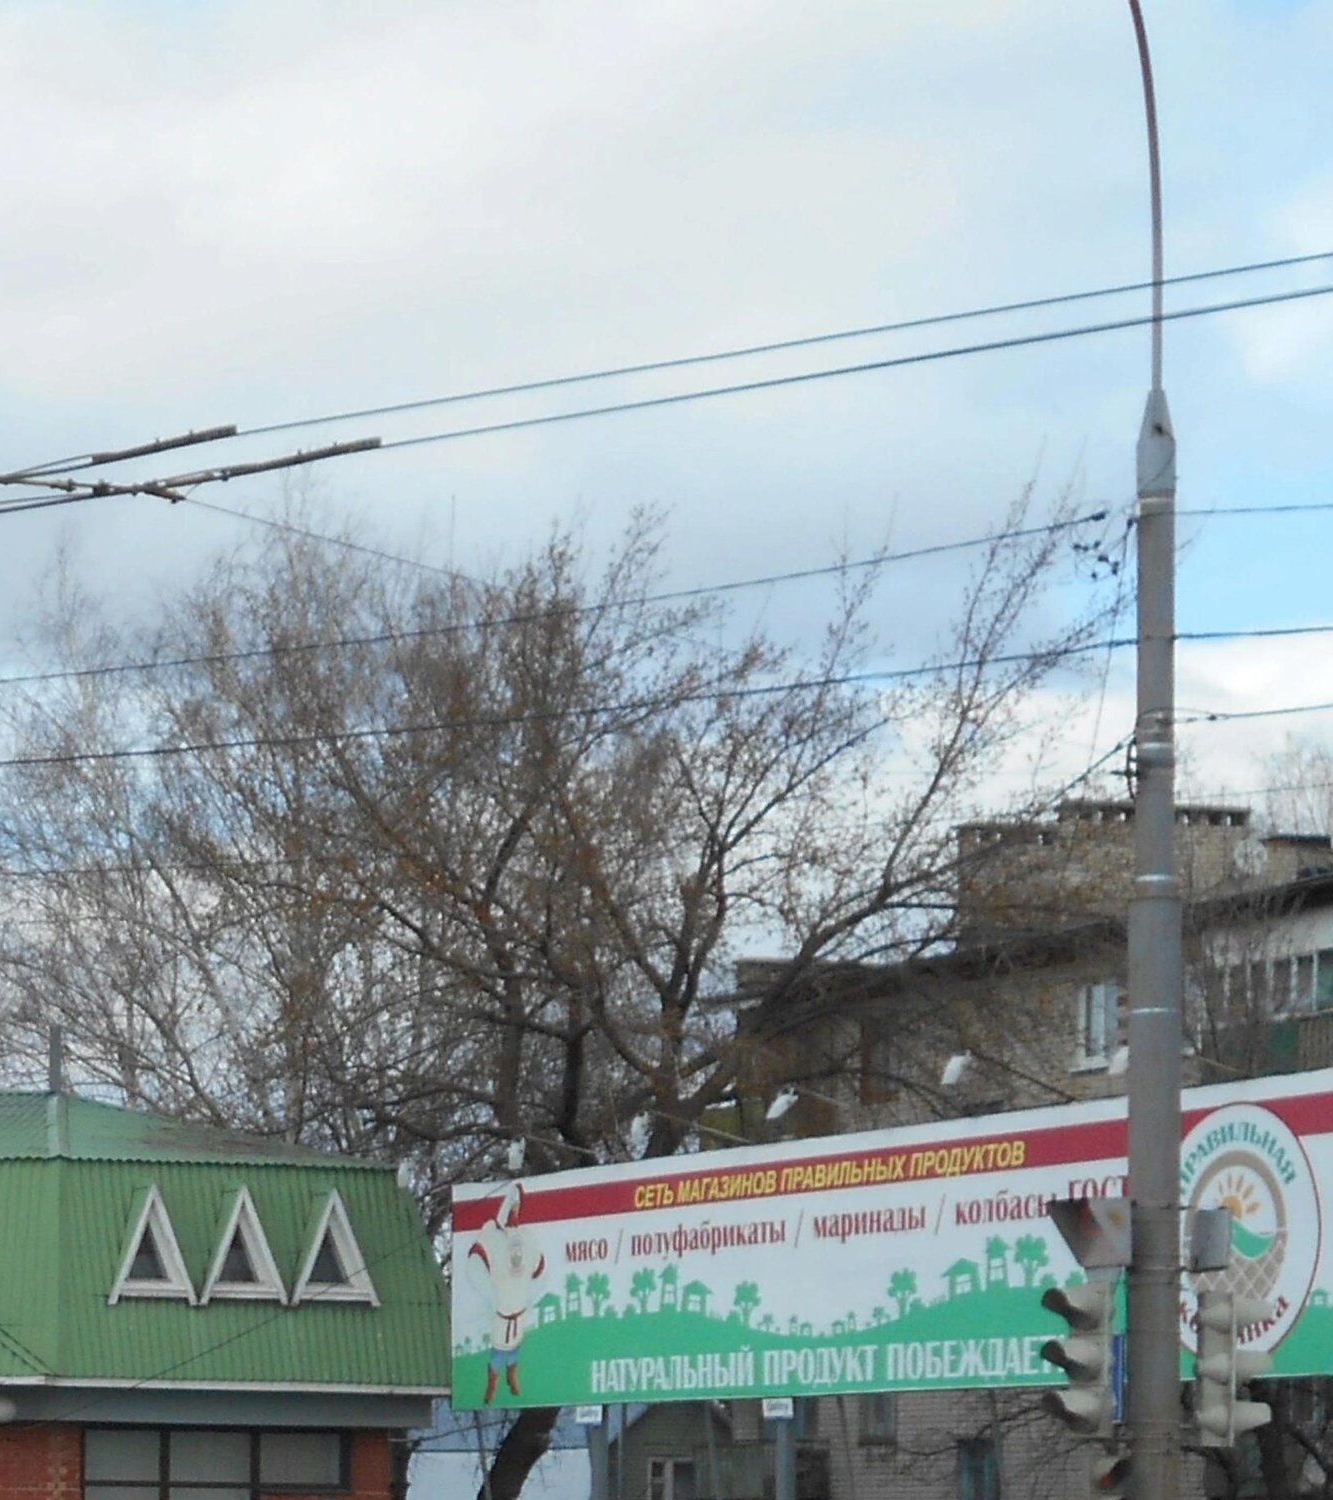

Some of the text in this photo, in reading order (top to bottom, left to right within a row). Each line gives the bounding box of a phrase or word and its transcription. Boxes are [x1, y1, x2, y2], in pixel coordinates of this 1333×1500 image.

[635, 1140, 1026, 1209] СЕТЬ МАГАЗИНОВ ПРАВИЛЬНЫХ ПРОДУКТОВ
[565, 1238, 608, 1262] мясо
[631, 1219, 786, 1260] полуфабрикаты
[813, 1206, 926, 1243] маринады
[955, 1189, 1057, 1225] колбасы
[591, 1345, 754, 1393] НАТУРАЛЬНЫЙ
[763, 1344, 879, 1388] ПРОДУКТ
